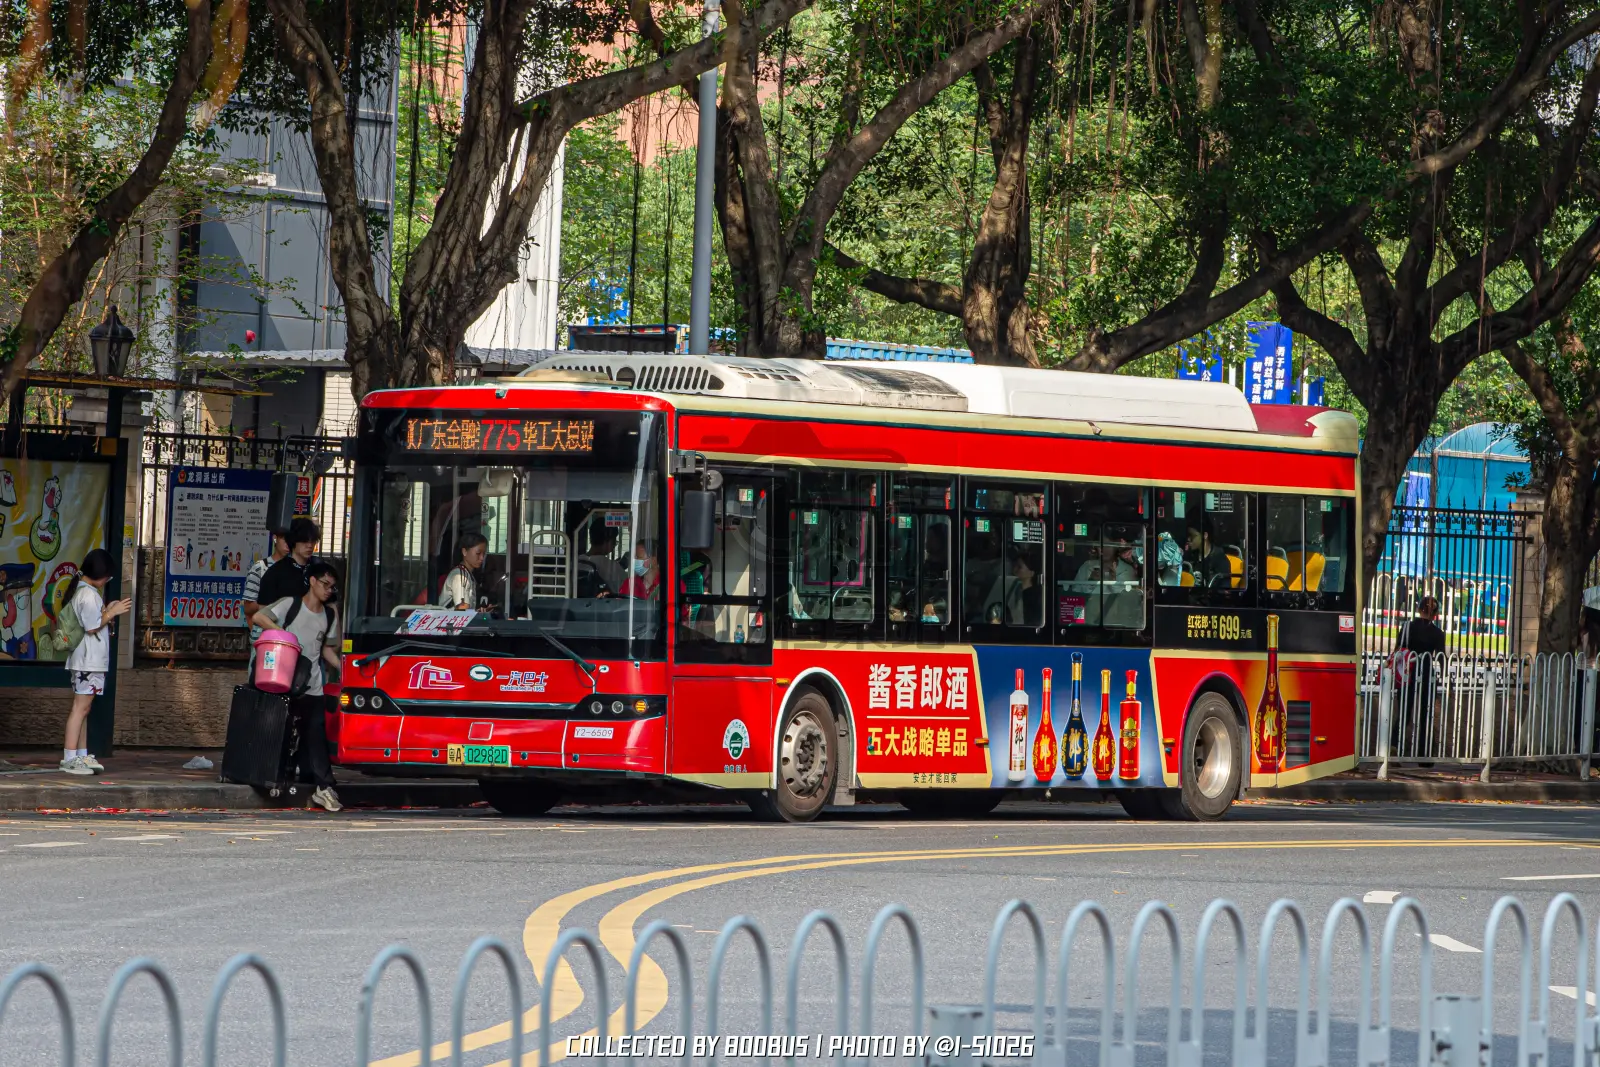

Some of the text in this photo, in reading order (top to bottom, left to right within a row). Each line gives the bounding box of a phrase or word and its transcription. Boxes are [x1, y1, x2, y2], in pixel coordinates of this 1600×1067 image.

[1263, 356, 1273, 400] 精益求精
[1276, 346, 1285, 390] 勇于创新
[1252, 361, 1262, 404] 朝气蓬勃
[481, 420, 520, 450] 775
[523, 420, 594, 451] 华工大总站
[187, 471, 225, 484] 龙洞派出所
[171, 580, 242, 594] 龙洞派出所值班电话
[170, 597, 241, 620] 87028656
[1220, 615, 1239, 640] 699
[496, 671, 549, 686] 一汽巴士
[868, 664, 969, 710] 酱香郎酒
[575, 727, 613, 737] Y2-6509
[867, 726, 968, 757] 五大战略单品
[449, 747, 507, 765] 粤A 02982D
